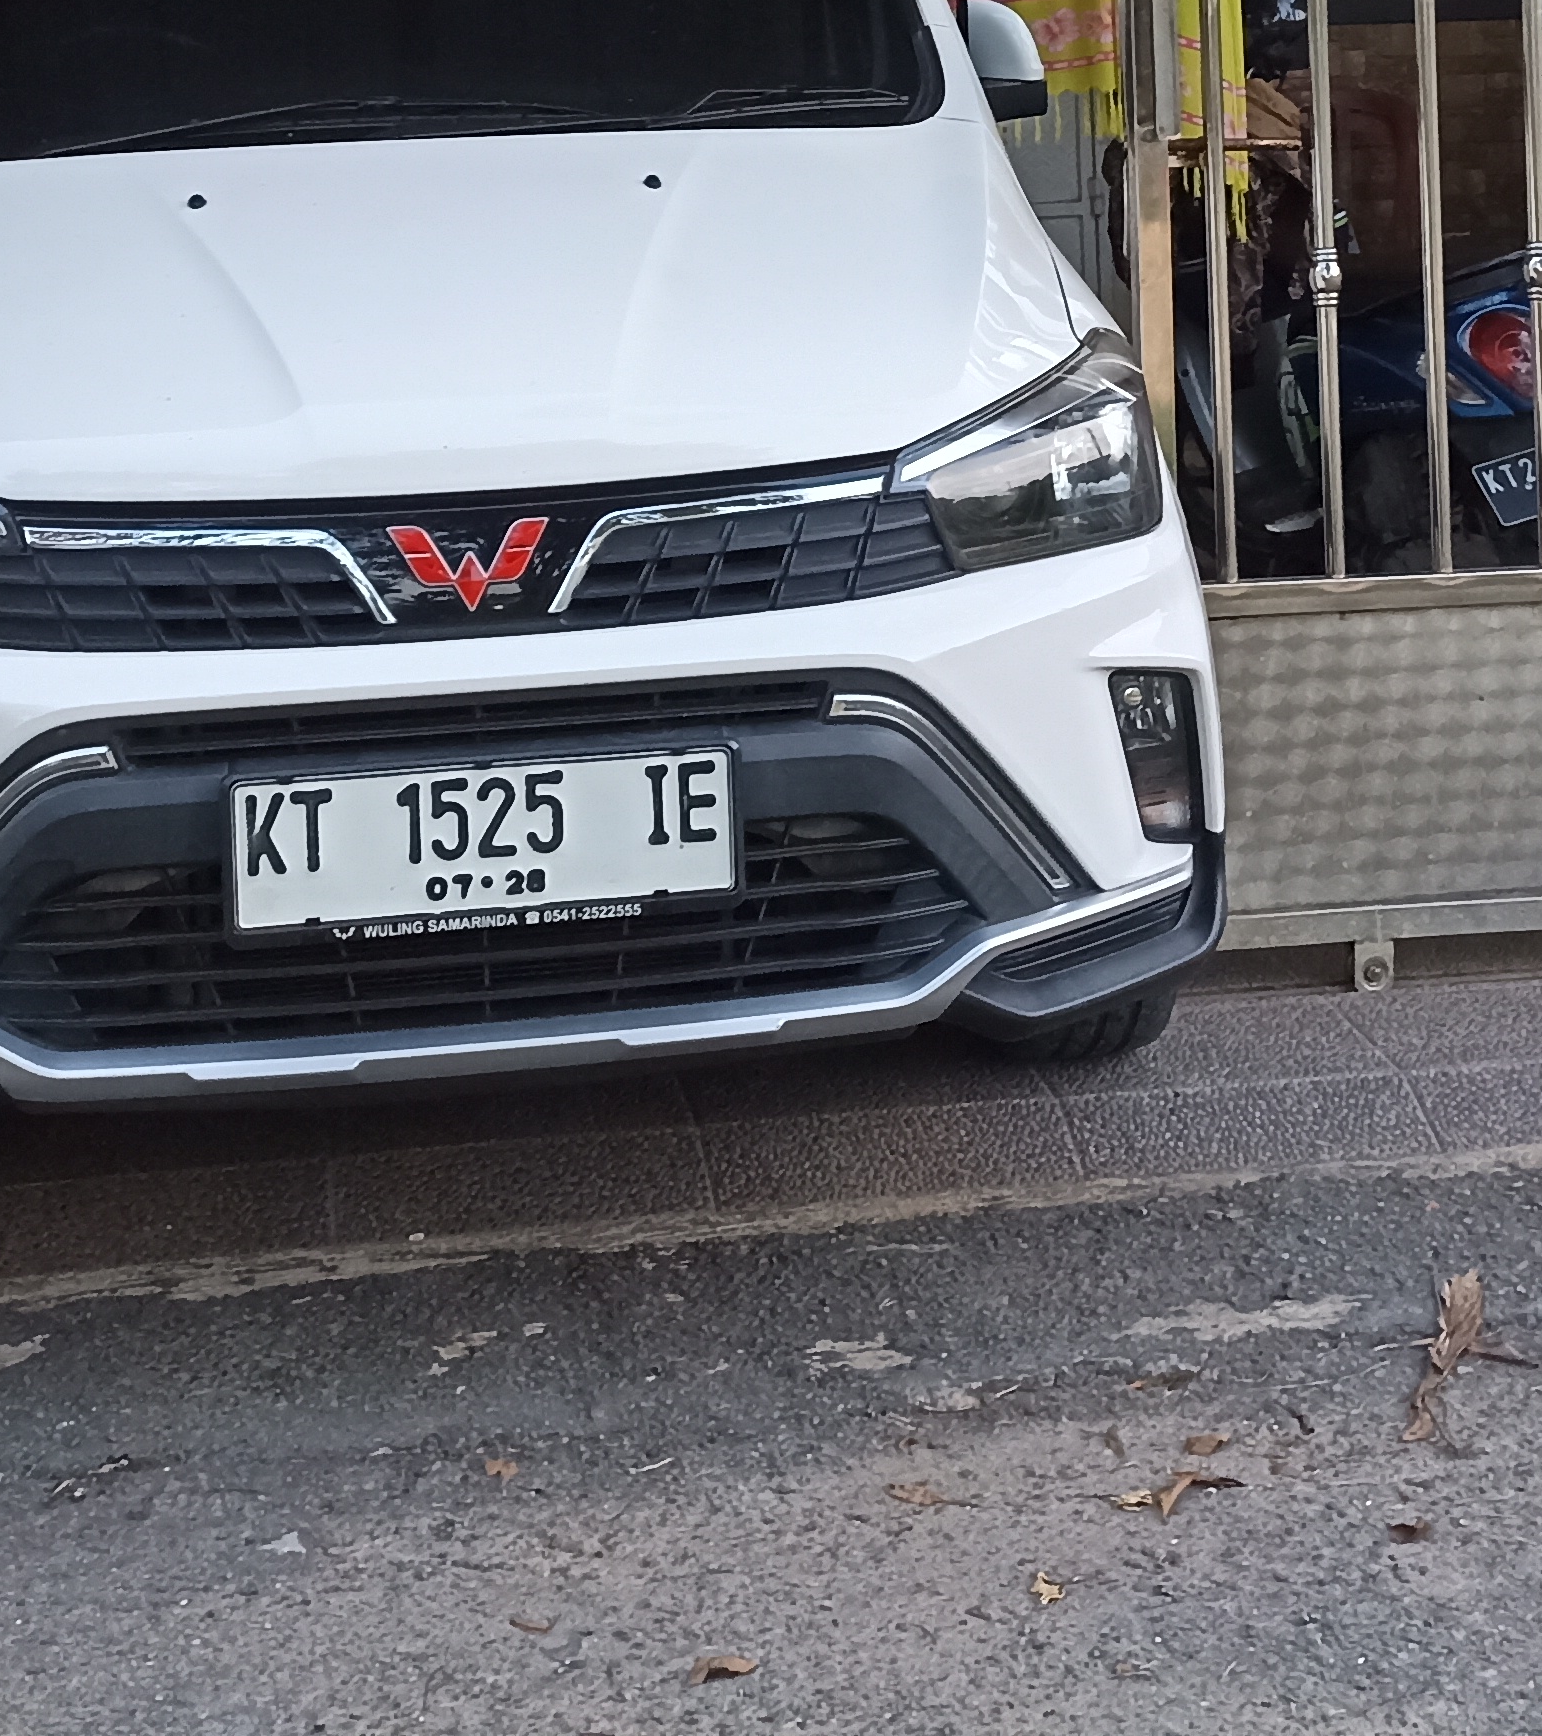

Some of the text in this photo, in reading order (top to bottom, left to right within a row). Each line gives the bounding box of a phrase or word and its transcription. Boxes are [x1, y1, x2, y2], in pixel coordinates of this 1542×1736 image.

[1481, 463, 1518, 494] KT
[244, 759, 718, 877] KT 1525 IE
[363, 903, 643, 939] WULING SAMARINDA 0541-2522555
